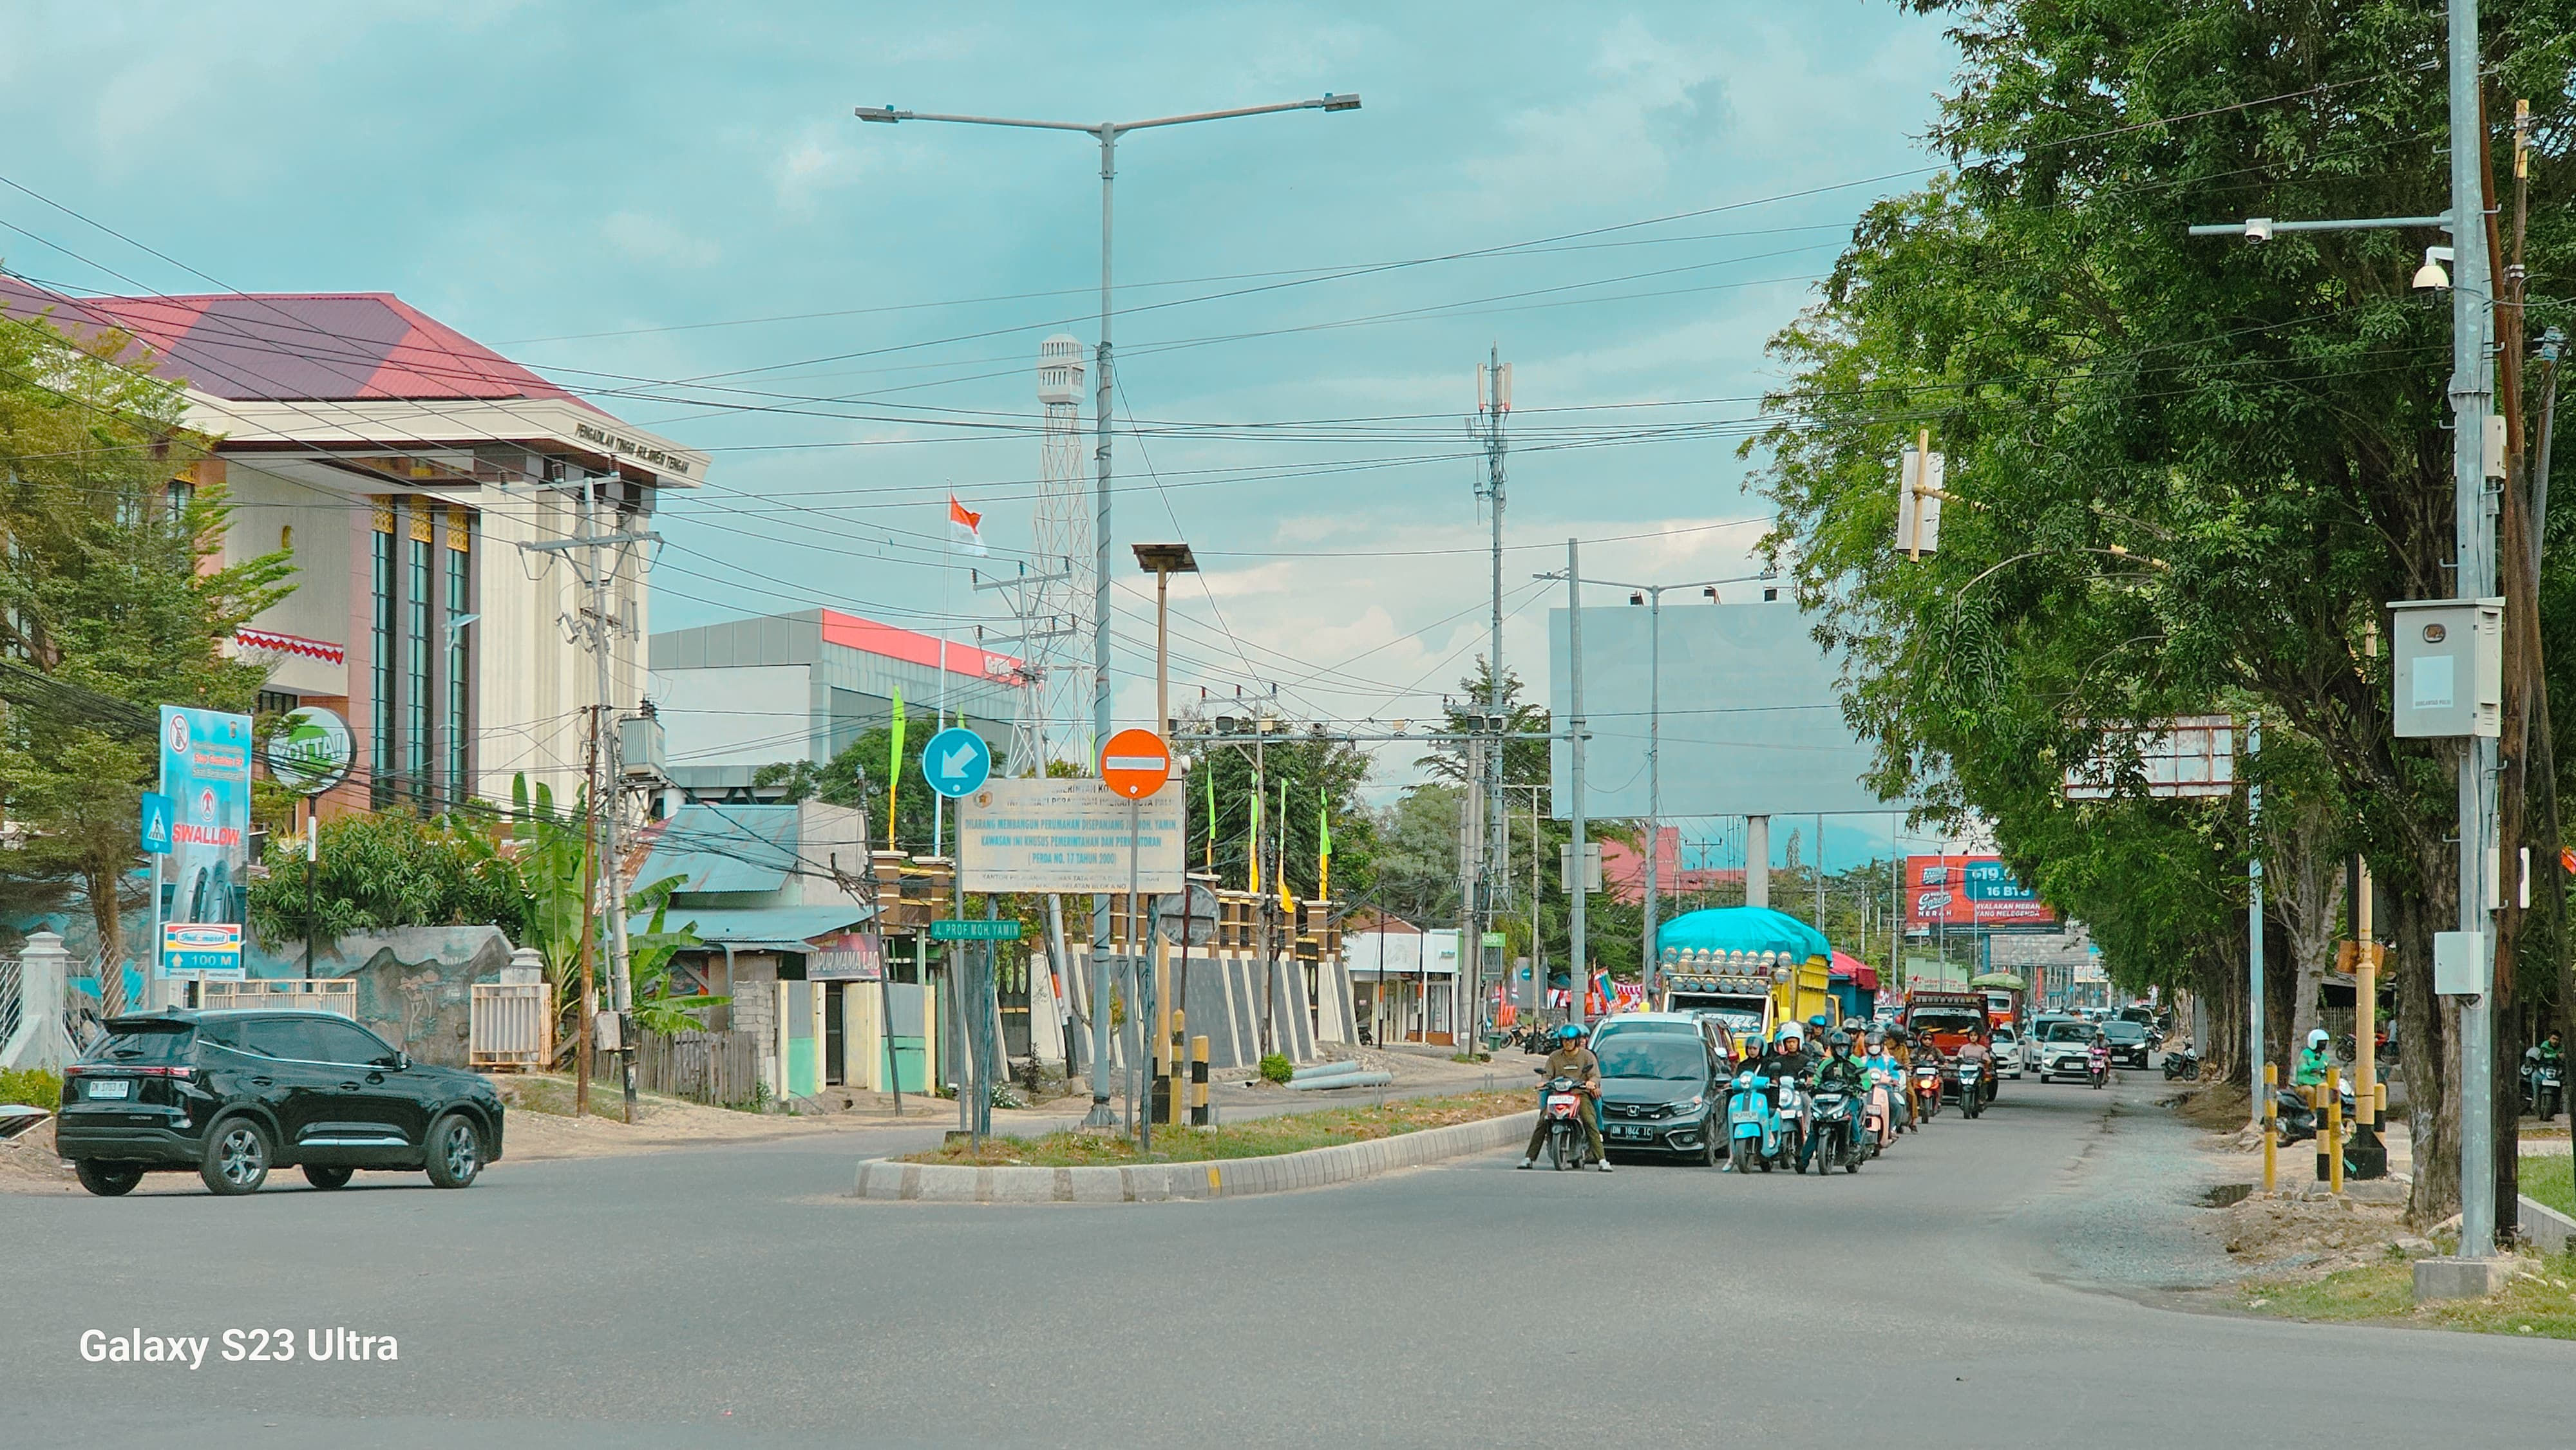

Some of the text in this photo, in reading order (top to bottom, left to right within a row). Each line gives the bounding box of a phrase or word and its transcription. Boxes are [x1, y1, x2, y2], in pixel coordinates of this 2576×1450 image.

[966, 819, 995, 829] DILARANG
[998, 819, 1039, 829] MEMBANGUN
[1041, 819, 1080, 829] PERUMAHAN
[1082, 819, 1124, 830] DISEPANJANG
[173, 824, 240, 846] SWALLOW
[981, 836, 1010, 846] KAWASAN
[1014, 836, 1022, 846] INI
[1025, 836, 1048, 846] KHUSUS
[1051, 836, 1099, 847] PEMERINTAHAN
[1101, 837, 1113, 847] DAN
[1067, 853, 1074, 863] 17
[1076, 853, 1097, 863] TAHUN
[1987, 887, 2000, 896] 16
[945, 923, 968, 936] PROF.
[971, 924, 990, 936] MOH.
[992, 924, 1018, 936] YAMIN
[191, 955, 232, 966] 100 M
[809, 951, 880, 971] DAPUR MAMA LAO
